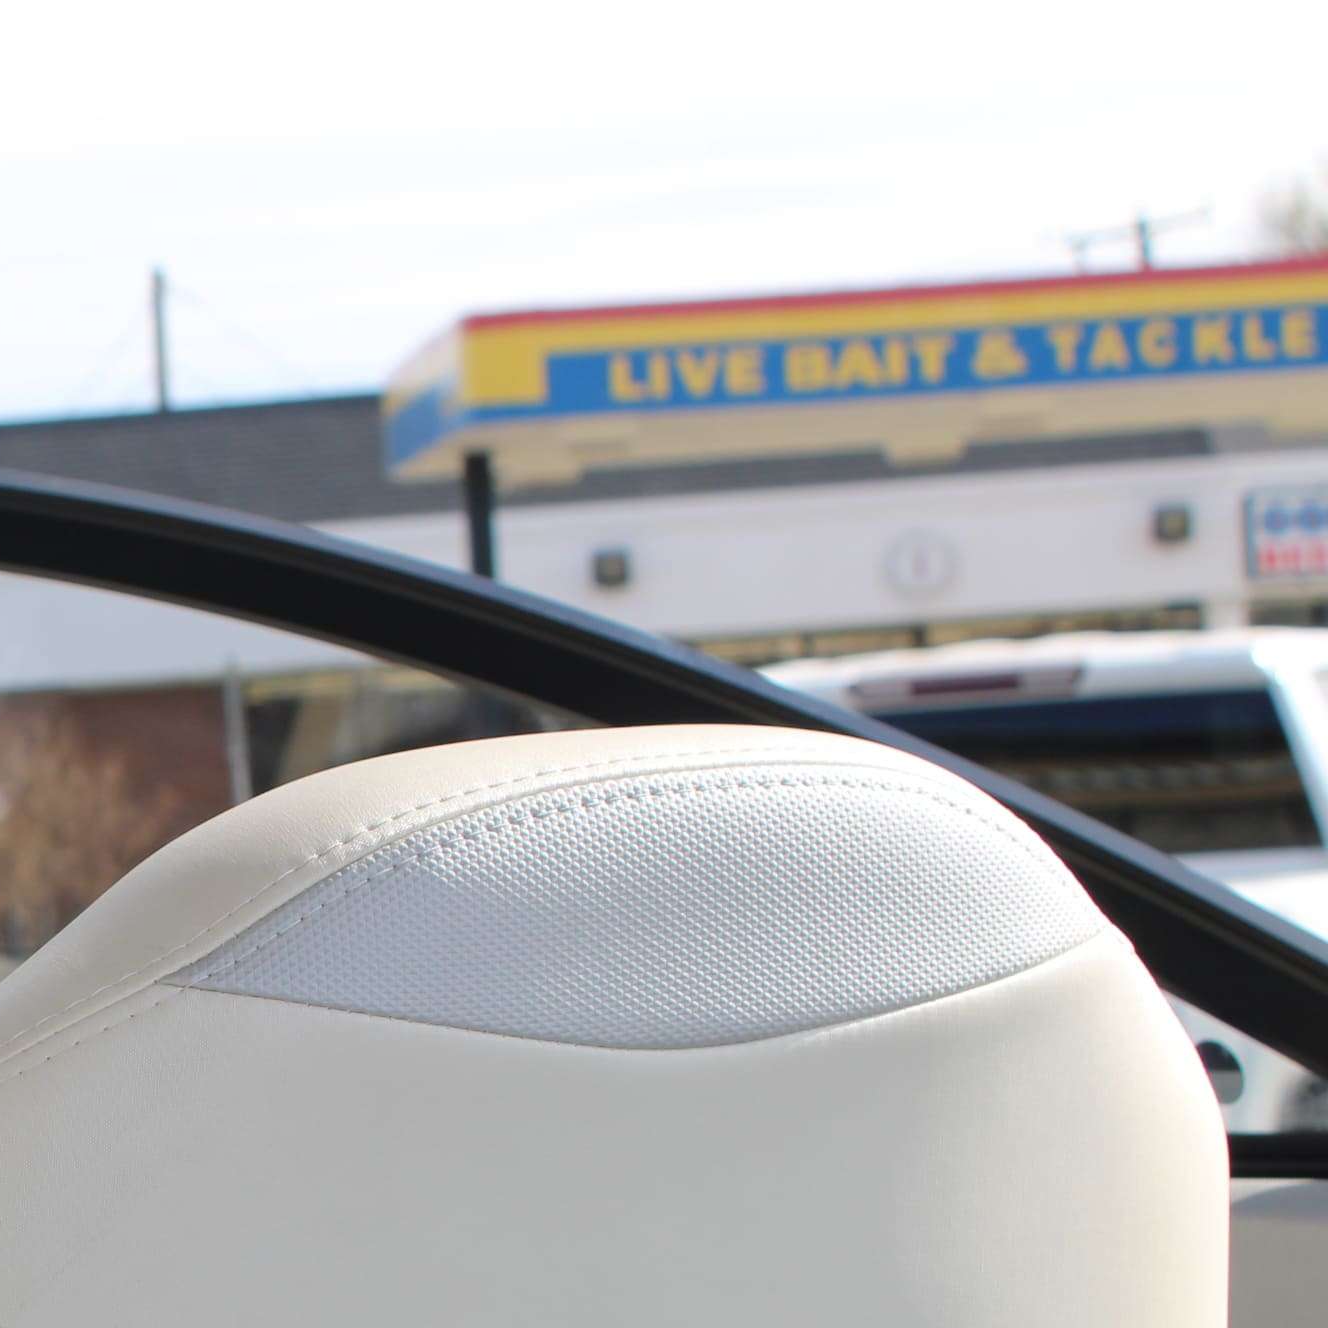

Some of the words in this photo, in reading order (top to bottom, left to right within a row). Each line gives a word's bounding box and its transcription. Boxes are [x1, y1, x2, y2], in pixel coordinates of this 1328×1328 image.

[610, 347, 762, 400] LIVE
[785, 337, 954, 393] BAIT
[973, 328, 1027, 379] &
[1048, 310, 1316, 374] TACKLE
